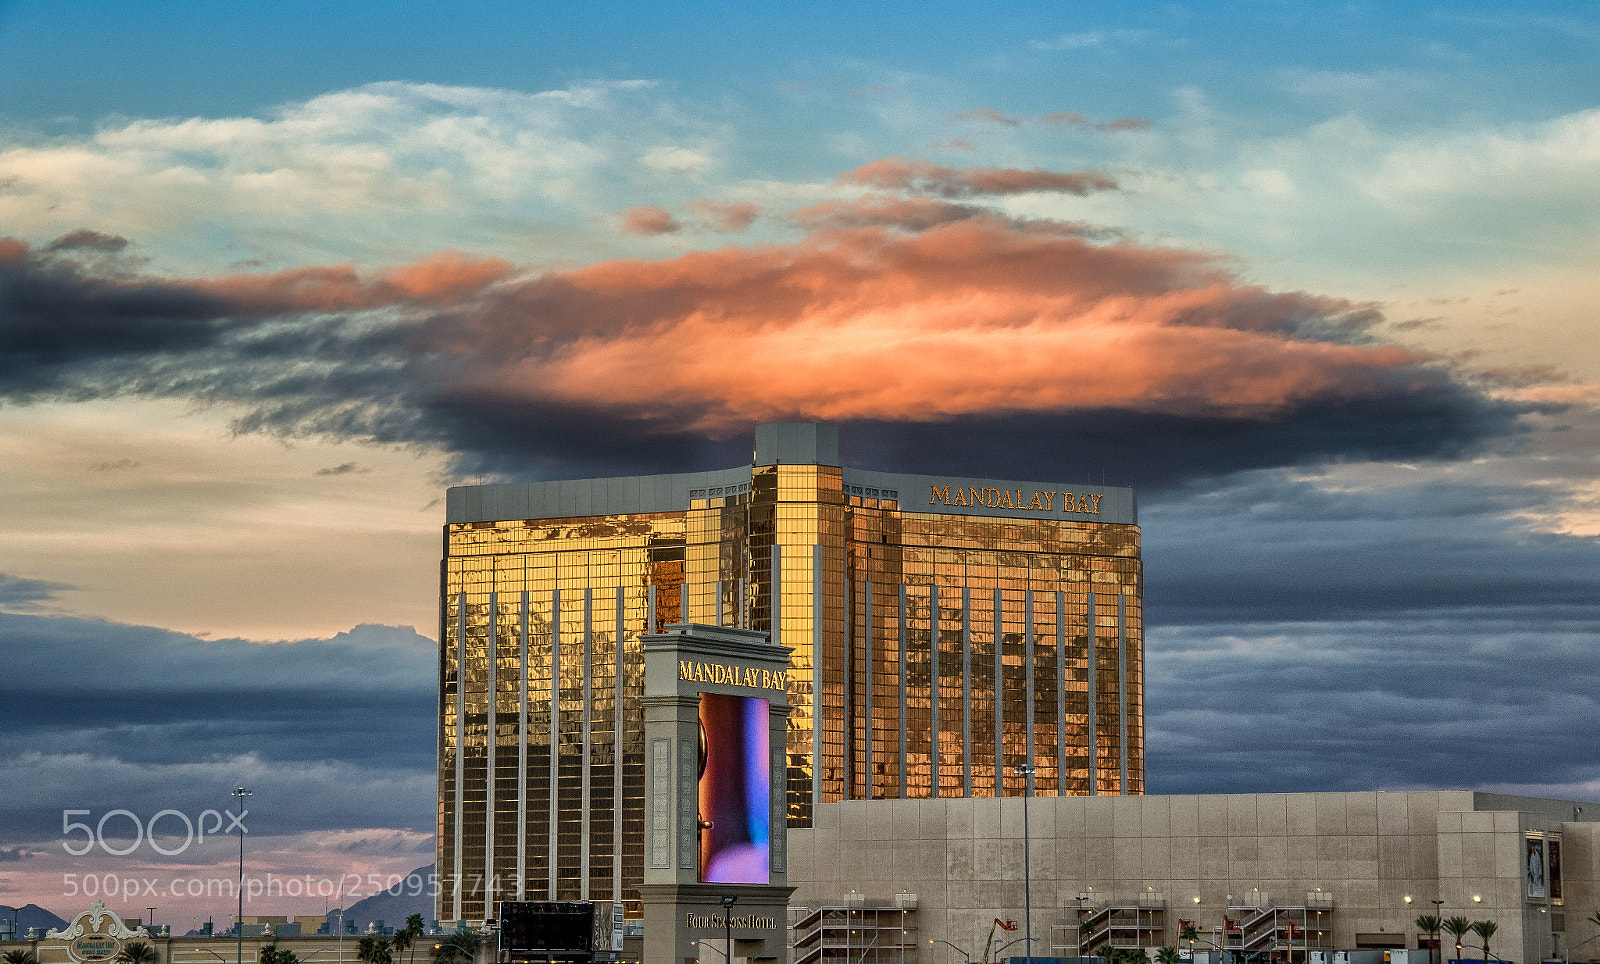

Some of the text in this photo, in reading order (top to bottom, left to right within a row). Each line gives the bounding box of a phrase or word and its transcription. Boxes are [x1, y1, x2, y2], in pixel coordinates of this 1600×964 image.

[929, 484, 1103, 514] MANDALAY BAY
[679, 660, 787, 691] MANDALAY BAY
[686, 912, 710, 929] FOUR
[748, 914, 778, 930] HOTEL
